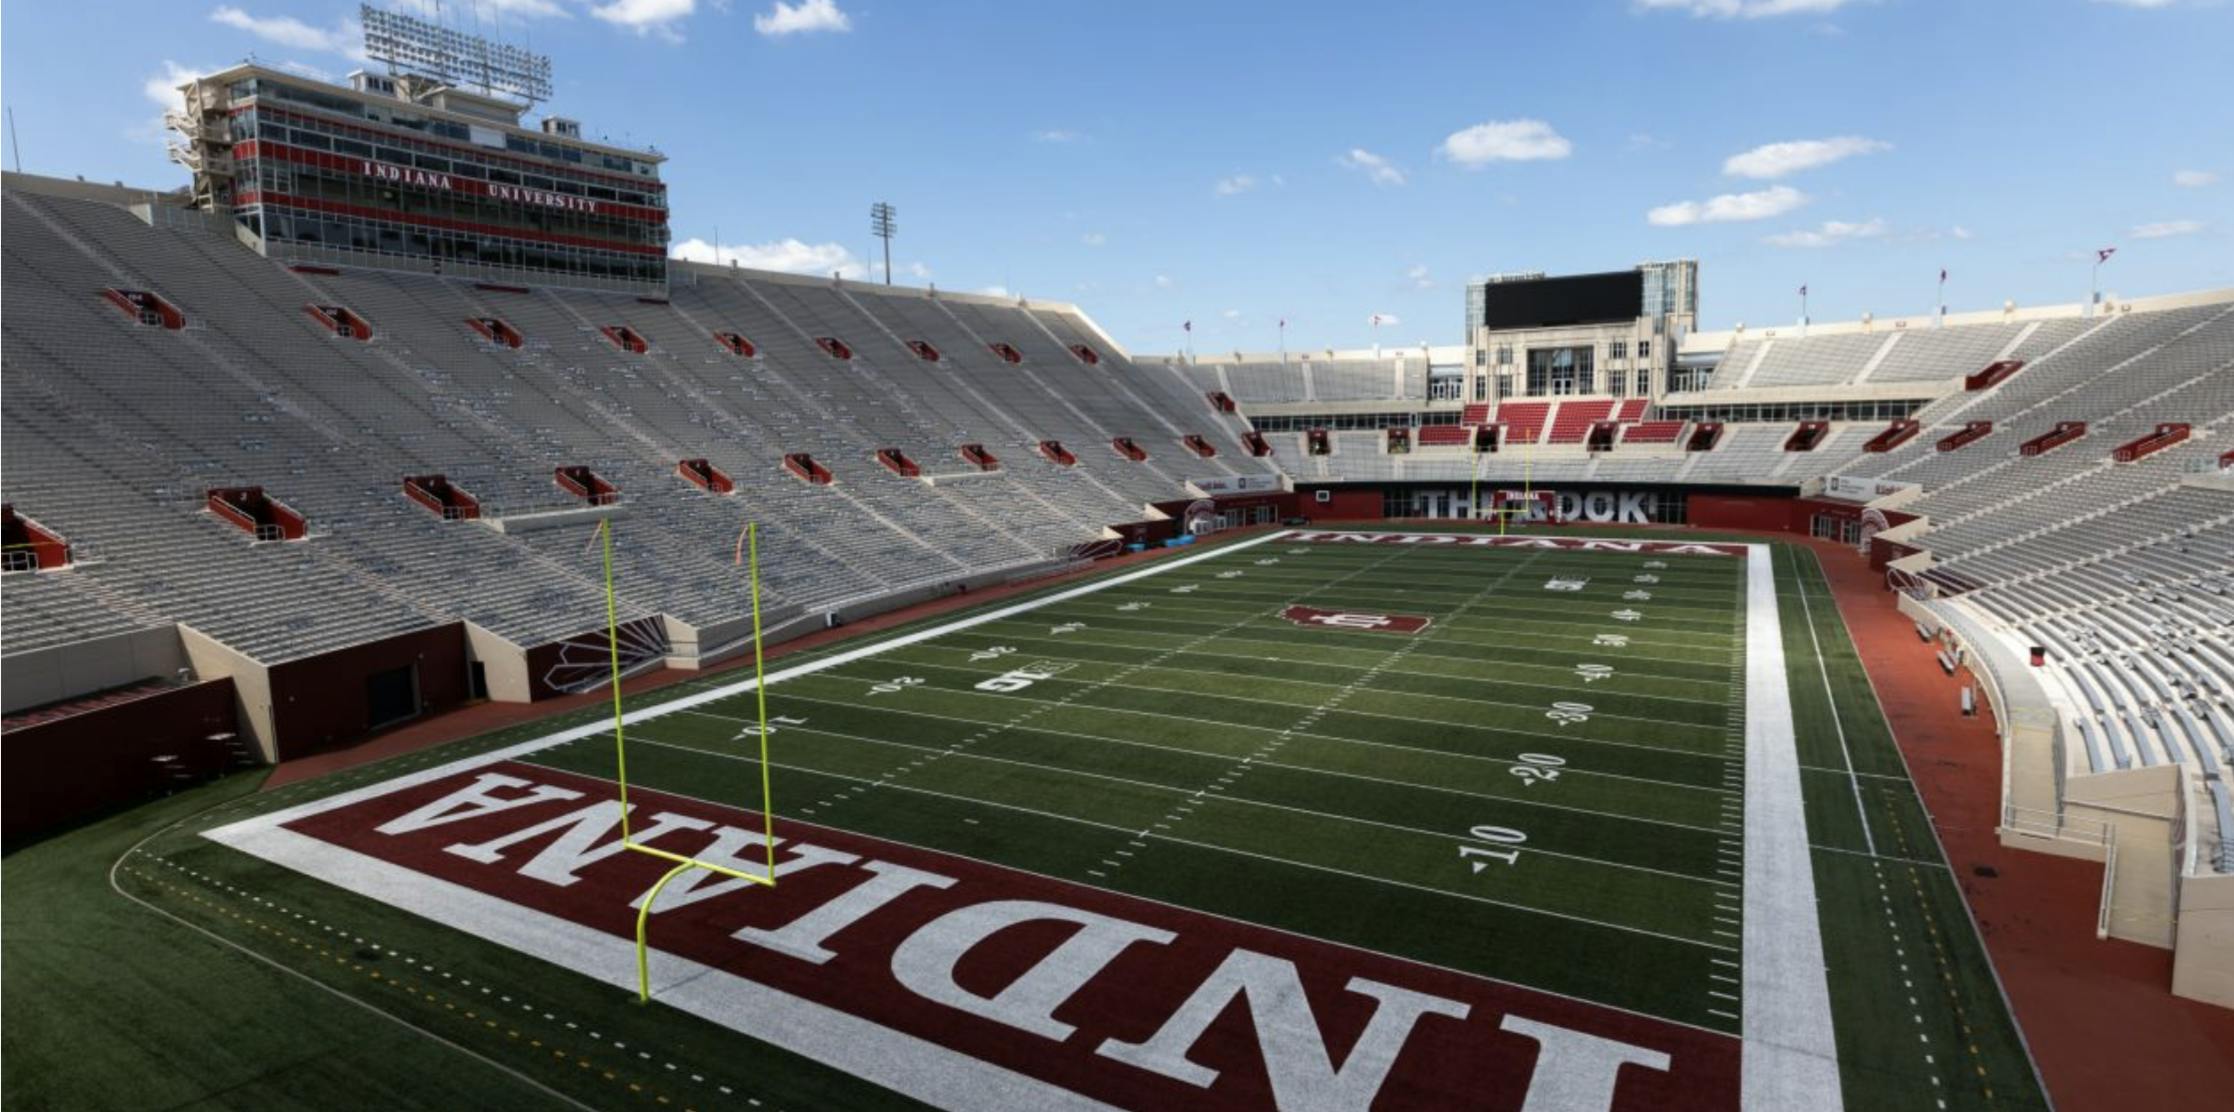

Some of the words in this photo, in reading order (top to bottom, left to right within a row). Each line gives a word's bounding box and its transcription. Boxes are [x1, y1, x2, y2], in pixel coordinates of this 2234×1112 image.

[363, 161, 452, 190] INDIANA
[488, 183, 597, 213] UNIVERSITY
[1289, 533, 1732, 555] INDIANA
[1545, 701, 1594, 722] 30
[742, 715, 808, 735] 10
[1509, 753, 1566, 781] 20
[1459, 825, 1527, 865] 10
